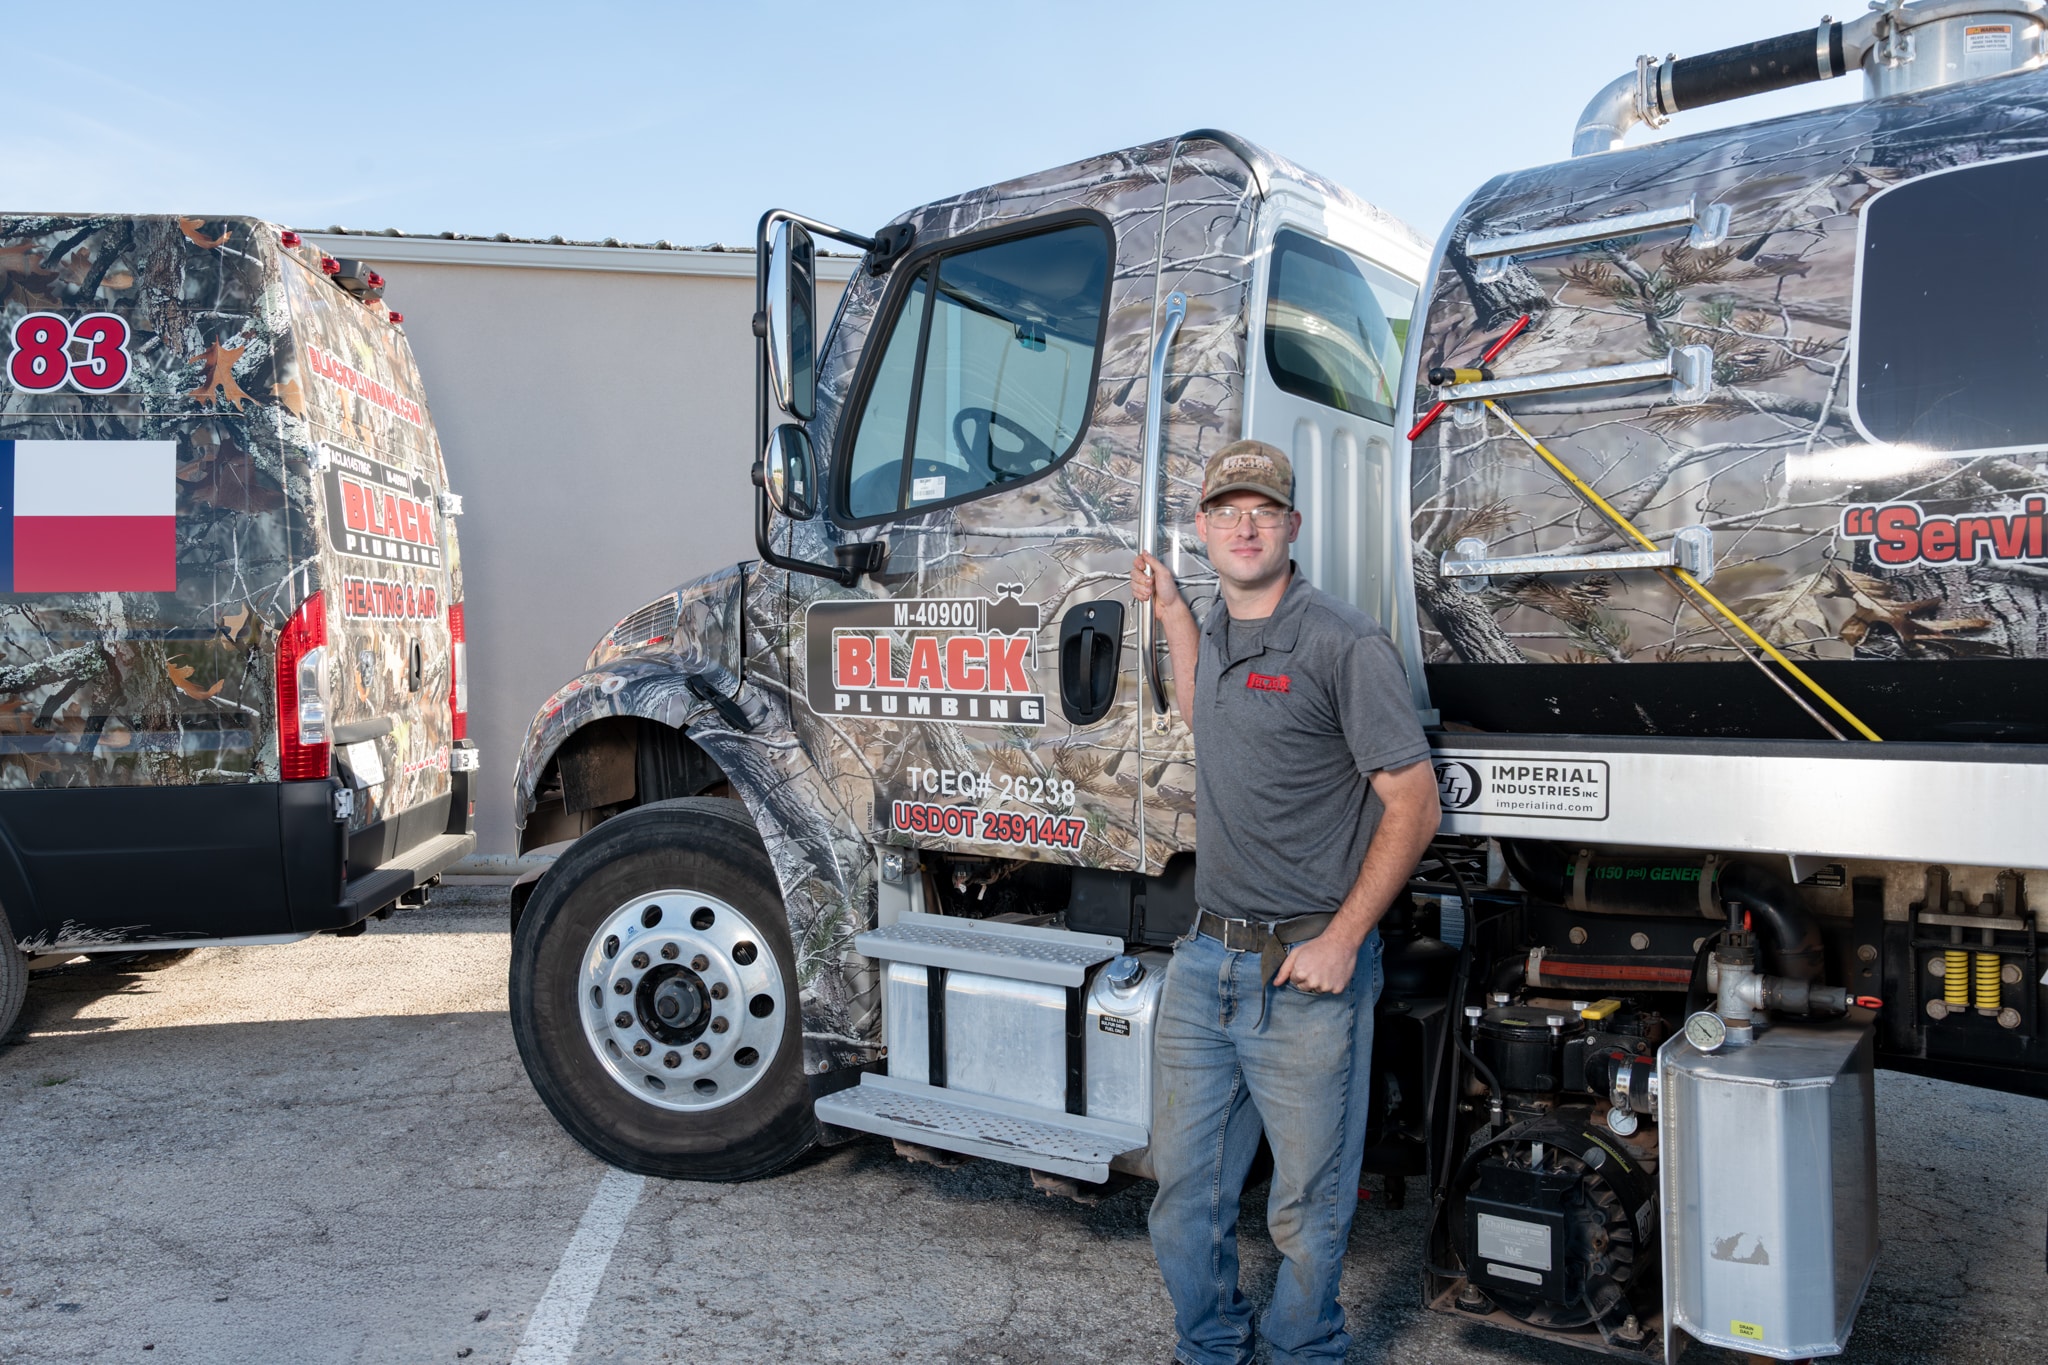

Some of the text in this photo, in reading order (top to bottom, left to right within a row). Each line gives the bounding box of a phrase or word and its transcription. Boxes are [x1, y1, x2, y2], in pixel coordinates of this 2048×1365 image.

[9, 313, 130, 392] 83
[307, 344, 423, 427] BLACKPLUMBING.COM
[342, 480, 435, 546] BLACK
[1845, 496, 2048, 563] “Servi
[346, 533, 440, 566] PLUMBING
[344, 577, 437, 619] HEATING & AIR
[893, 602, 974, 626] M-40900
[837, 637, 1031, 692] BLACK
[834, 694, 1040, 720] PLUMBING
[907, 766, 1076, 807] TCEQ# 26238
[1491, 783, 1580, 797] INDUSTRIES
[1492, 765, 1598, 783] IMPERIAL
[894, 802, 1086, 849] USDOT 2591447
[1496, 799, 1593, 812] imperialind.com
[1595, 867, 1623, 879] (150
[1626, 868, 1647, 880] psi)
